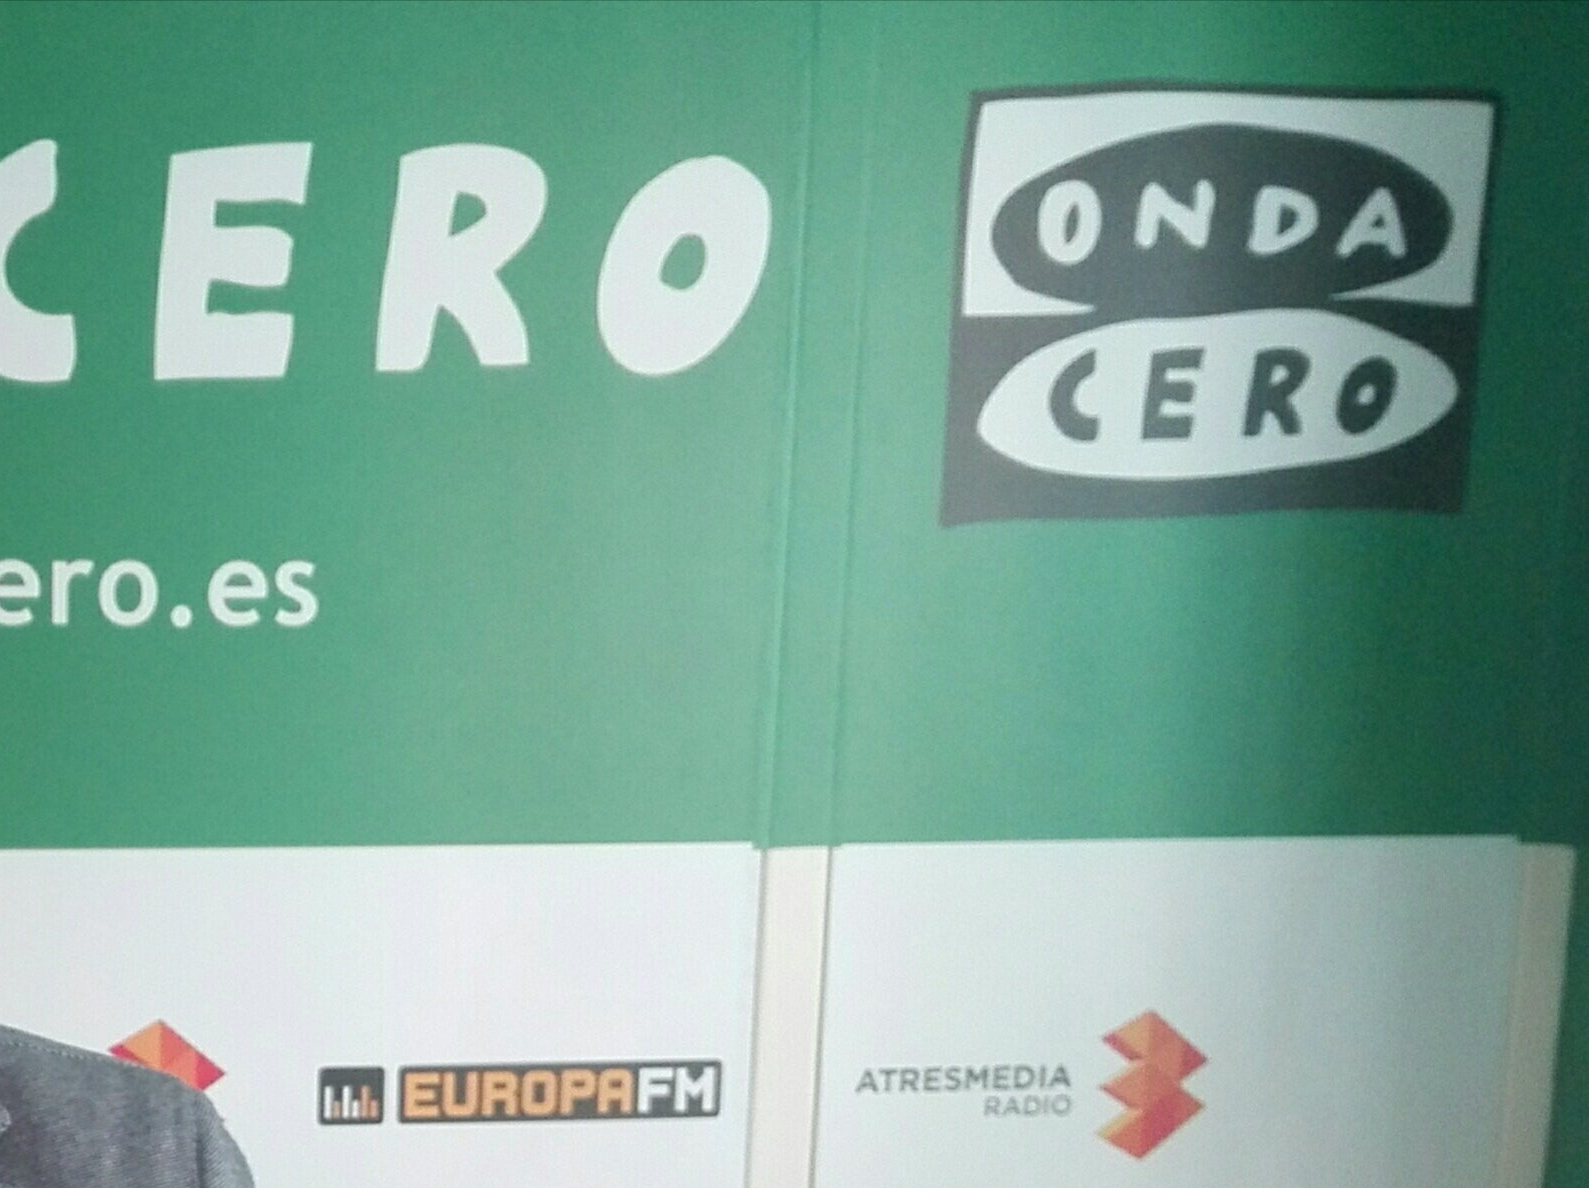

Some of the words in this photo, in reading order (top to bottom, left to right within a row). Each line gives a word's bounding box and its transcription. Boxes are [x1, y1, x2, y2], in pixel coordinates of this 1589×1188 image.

[1038, 179, 1406, 266] ONDA
[1048, 347, 1398, 442] CERO
[855, 1063, 1072, 1094] ATRESMEDIA
[983, 1094, 1073, 1117] RADIO
